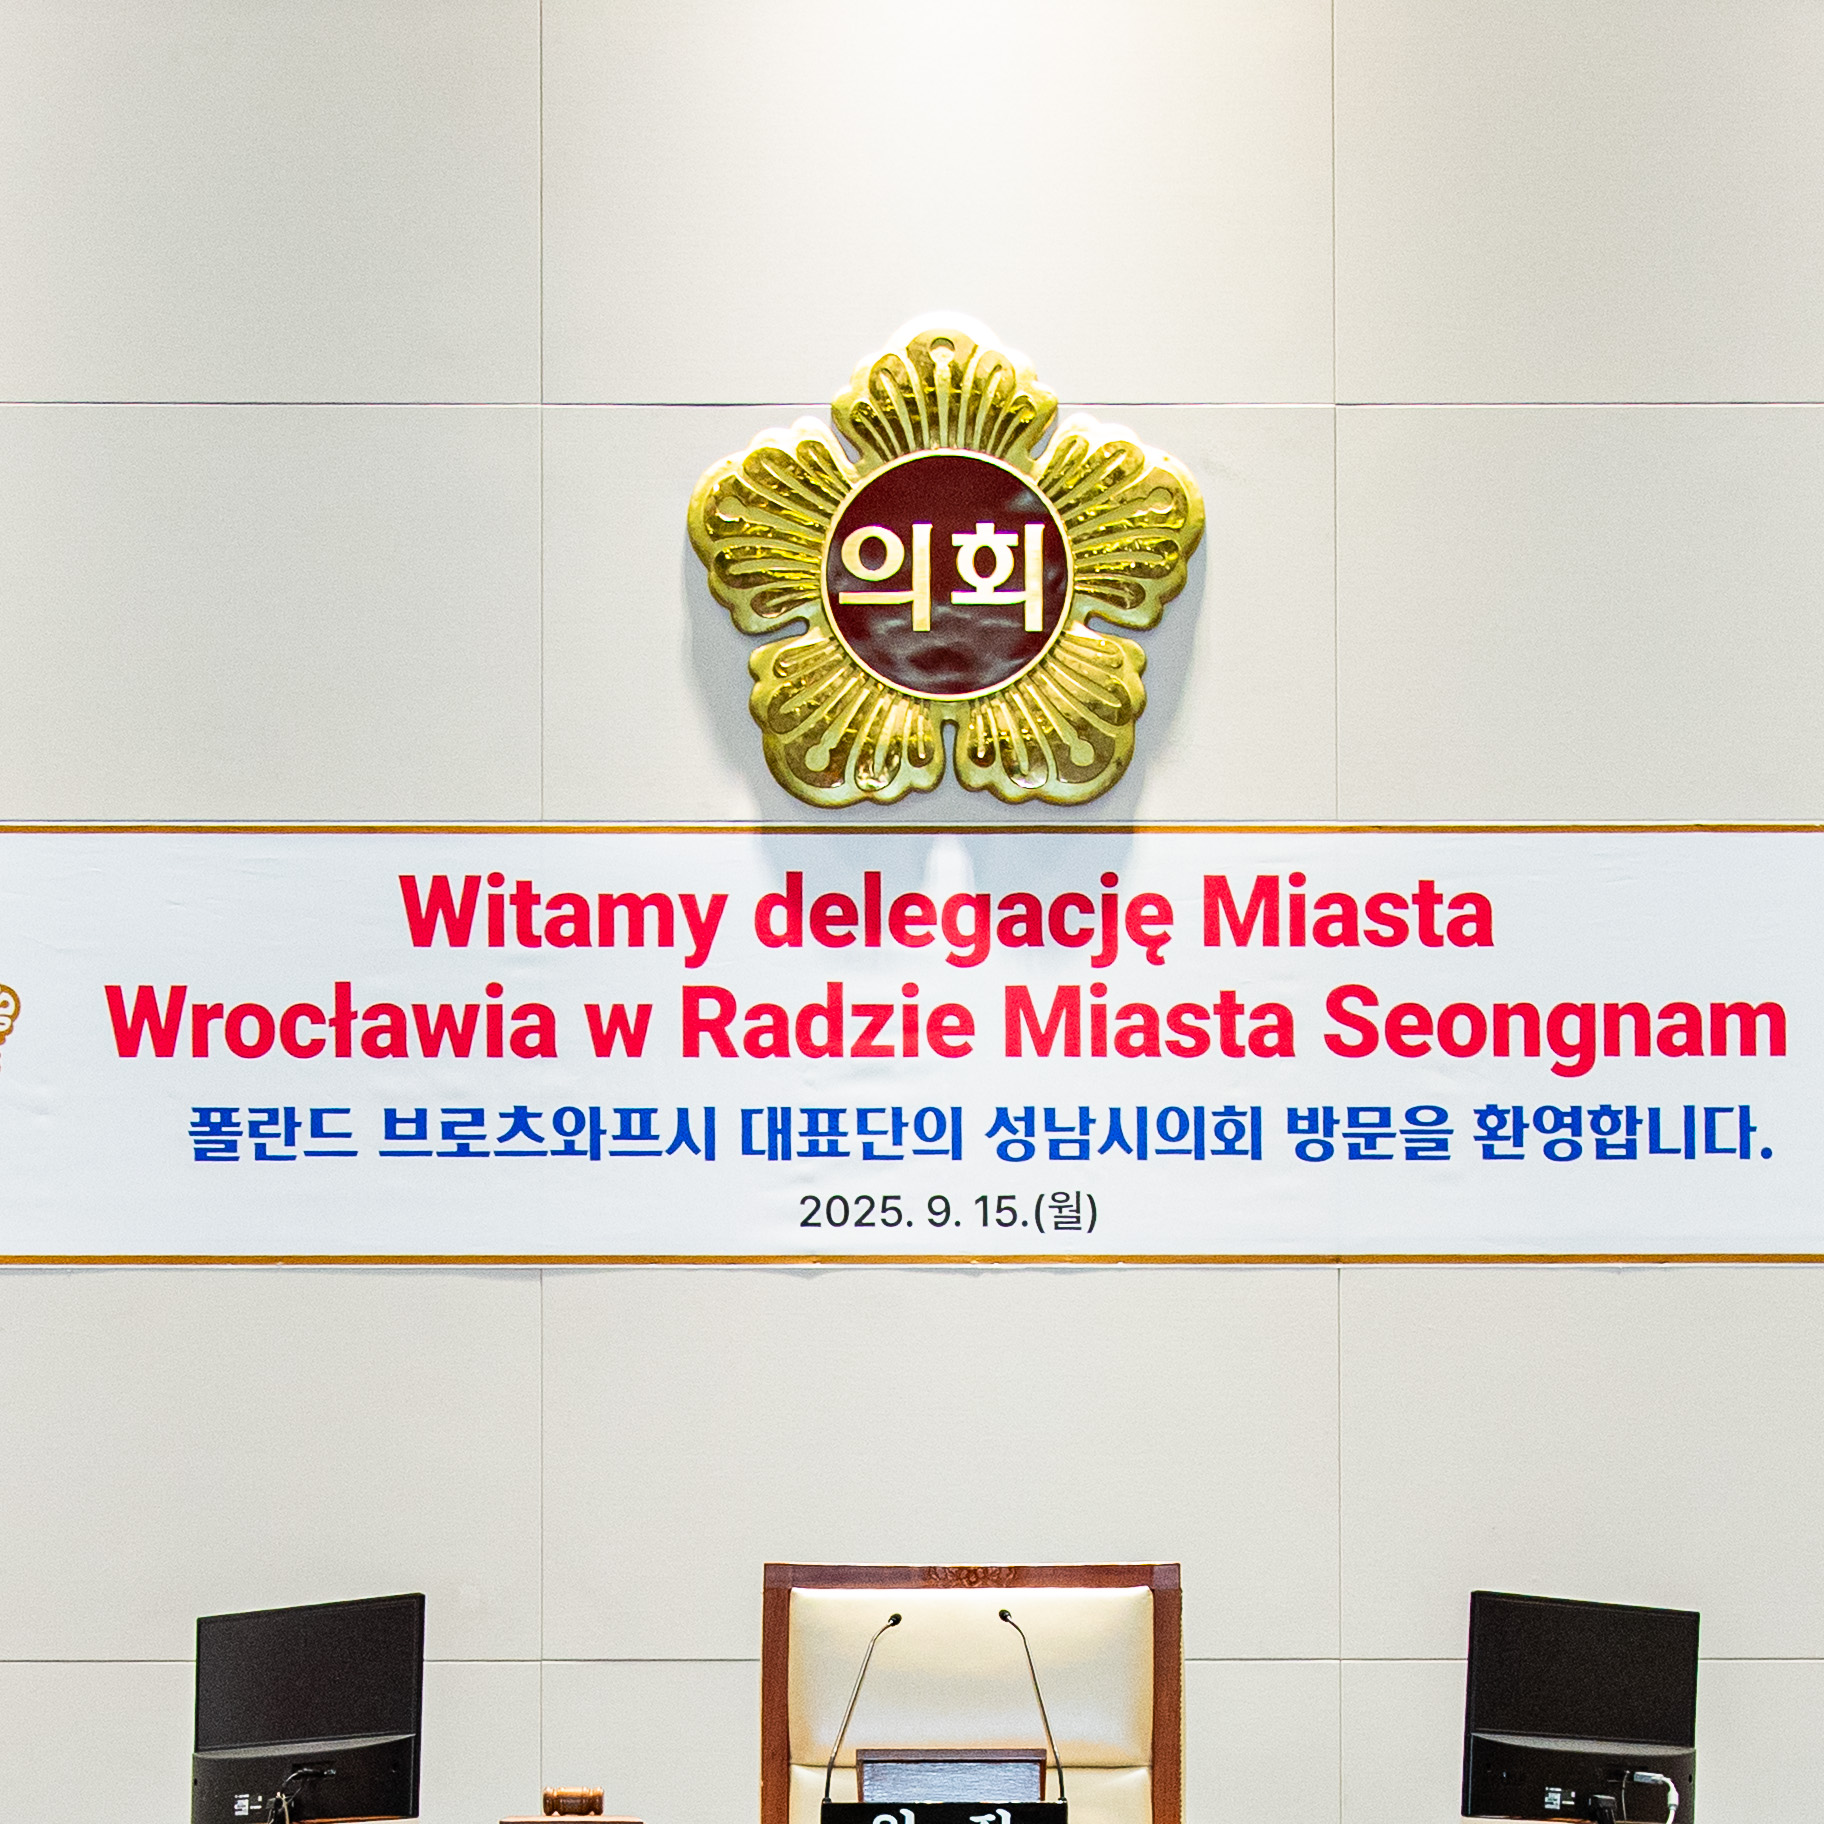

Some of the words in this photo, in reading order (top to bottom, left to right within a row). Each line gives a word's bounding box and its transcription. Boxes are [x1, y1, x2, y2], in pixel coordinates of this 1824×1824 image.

[838, 521, 1046, 632] 의회
[399, 871, 728, 969] Witamy
[754, 871, 1174, 969] delegację
[1203, 872, 1494, 948] Miasta
[105, 981, 558, 1059] Wrocławia
[584, 1003, 653, 1058] w
[682, 981, 975, 1059] Radzie
[1004, 981, 1295, 1059] Miasta
[1323, 983, 1787, 1079] Seongnam
[188, 1105, 359, 1161] 폴란드
[379, 1104, 716, 1162] 브로츠와프시
[741, 1105, 963, 1161] 대표단의
[985, 1104, 1263, 1162] 성남시의회
[1287, 1104, 1455, 1162] 방문을
[1473, 1104, 1773, 1162] 환영합니다.
[800, 1194, 913, 1228] 2025.
[927, 1194, 961, 1228] 9.
[974, 1190, 1098, 1234] 15.(월)
